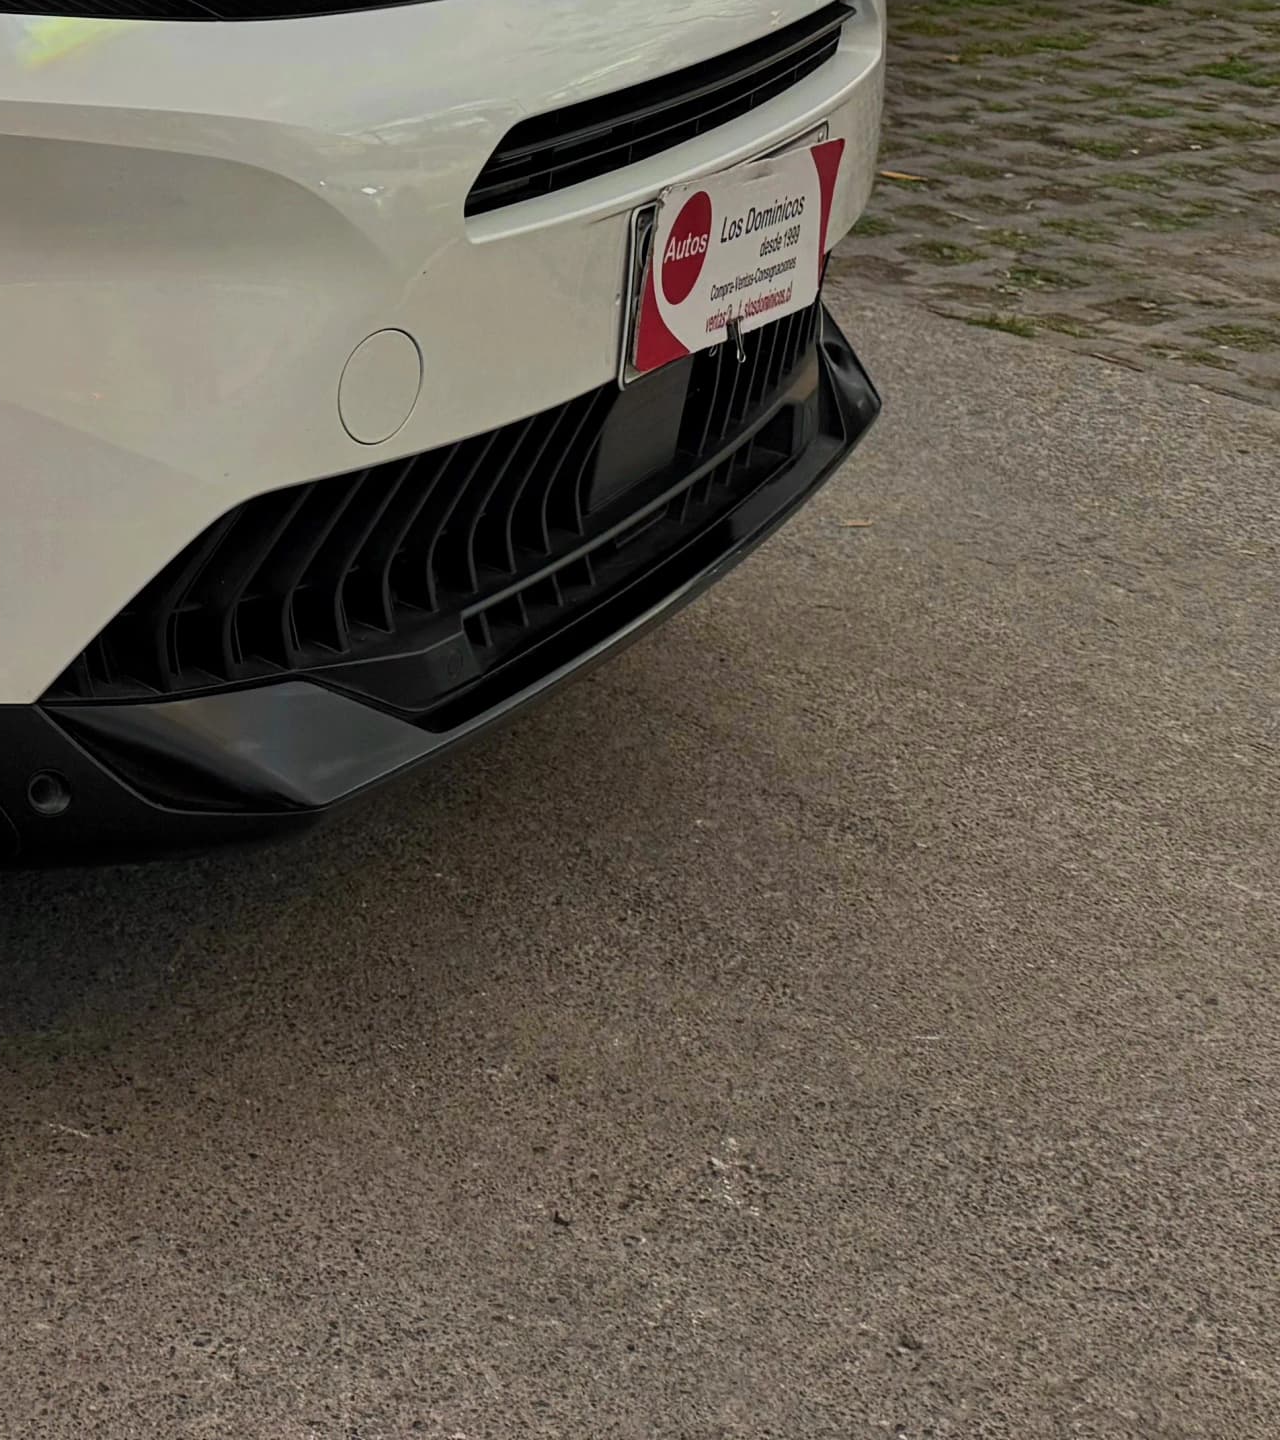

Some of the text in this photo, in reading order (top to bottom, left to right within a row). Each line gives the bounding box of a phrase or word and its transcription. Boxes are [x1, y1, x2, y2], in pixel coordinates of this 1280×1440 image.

[720, 196, 805, 243] Los Dominicos
[663, 232, 708, 264] Autos
[760, 231, 782, 257] desde
